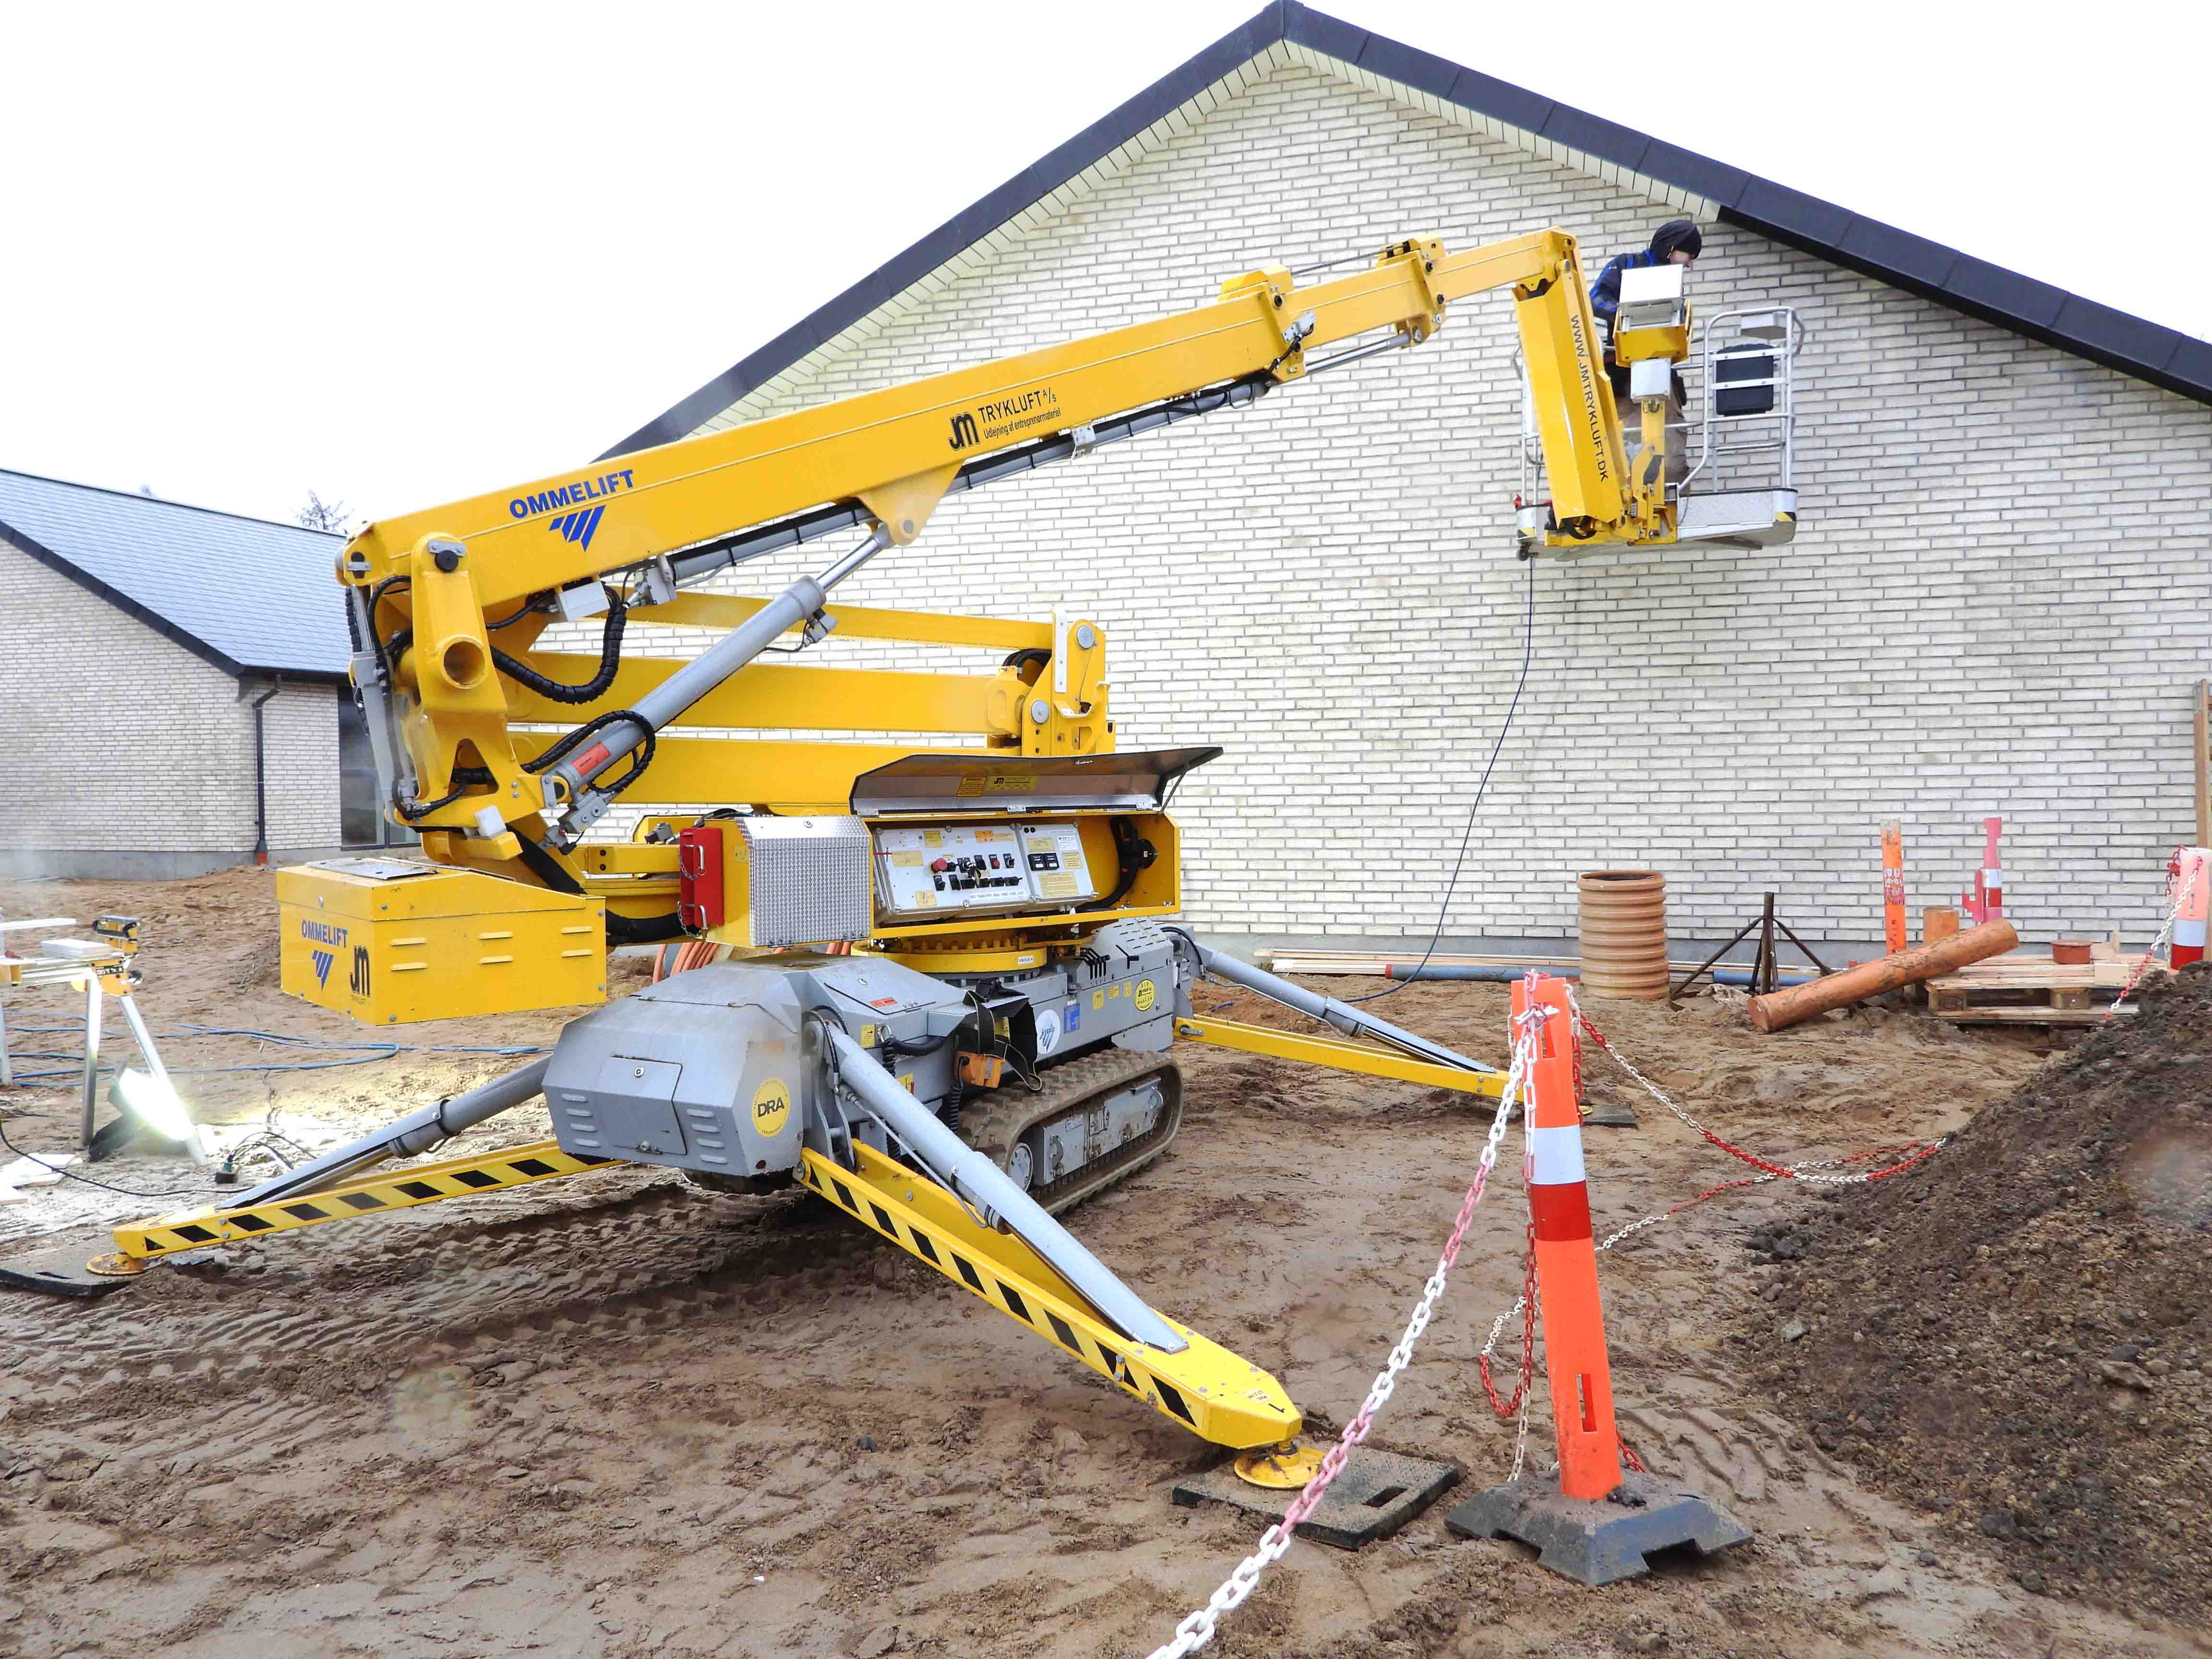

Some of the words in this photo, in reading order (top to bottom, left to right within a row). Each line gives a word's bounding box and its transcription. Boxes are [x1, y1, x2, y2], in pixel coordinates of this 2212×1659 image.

[978, 391, 1041, 423] TRYKLUFT
[1571, 314, 1609, 482] WWW.JMTRYKLUFT.DK
[984, 424, 1009, 439] Udlejning
[1009, 421, 1014, 432] af
[509, 469, 634, 518] OMMELIFT
[302, 919, 348, 948] OMMELIFT
[757, 1096, 785, 1118] DRA
